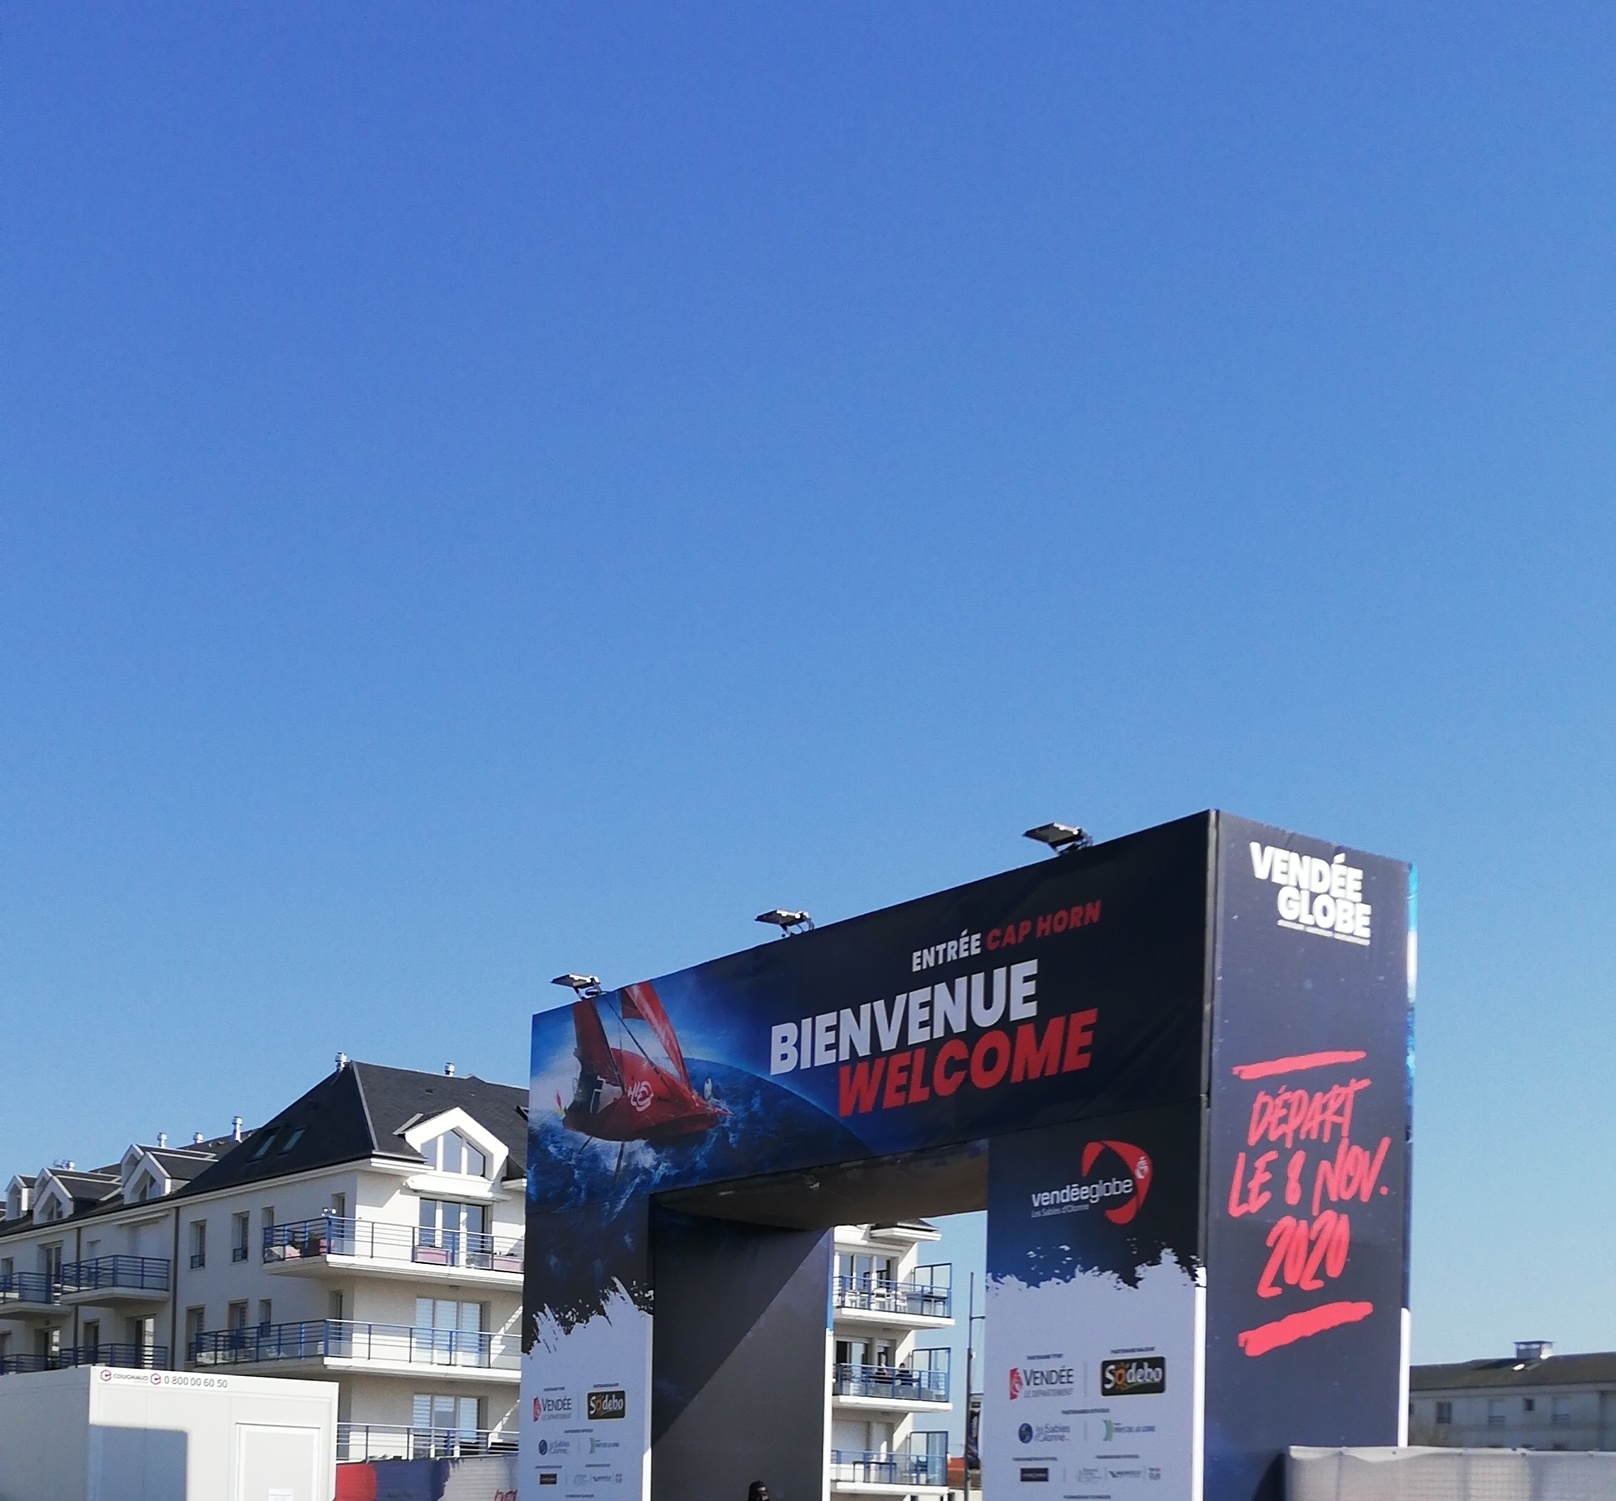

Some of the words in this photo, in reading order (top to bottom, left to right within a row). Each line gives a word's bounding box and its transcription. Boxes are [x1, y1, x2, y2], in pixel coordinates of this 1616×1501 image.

[1250, 841, 1363, 902] VENDÉE
[912, 928, 982, 973] ENTRÉE
[986, 920, 1031, 951] CAP
[1035, 900, 1102, 939] HORN
[1277, 885, 1371, 938] GLOBE
[770, 958, 1039, 1076] BIENVENUE
[838, 1008, 1098, 1118] WELCOME
[1247, 1078, 1372, 1149] DÉPART
[1228, 1150, 1279, 1218] LE
[1286, 1150, 1306, 1206] 8
[1312, 1136, 1391, 1217] NOV.
[1257, 1209, 1350, 1298] 2020
[164, 1375, 170, 1385] 0
[172, 1376, 188, 1386] 800
[190, 1377, 201, 1387] 00
[203, 1378, 214, 1388] 60
[217, 1379, 228, 1389] 50
[541, 1396, 572, 1412] VENDÉE
[589, 1394, 624, 1415] Sodebo
[1023, 1365, 1074, 1386] VENDÉE
[1104, 1362, 1163, 1389] Sodebo
